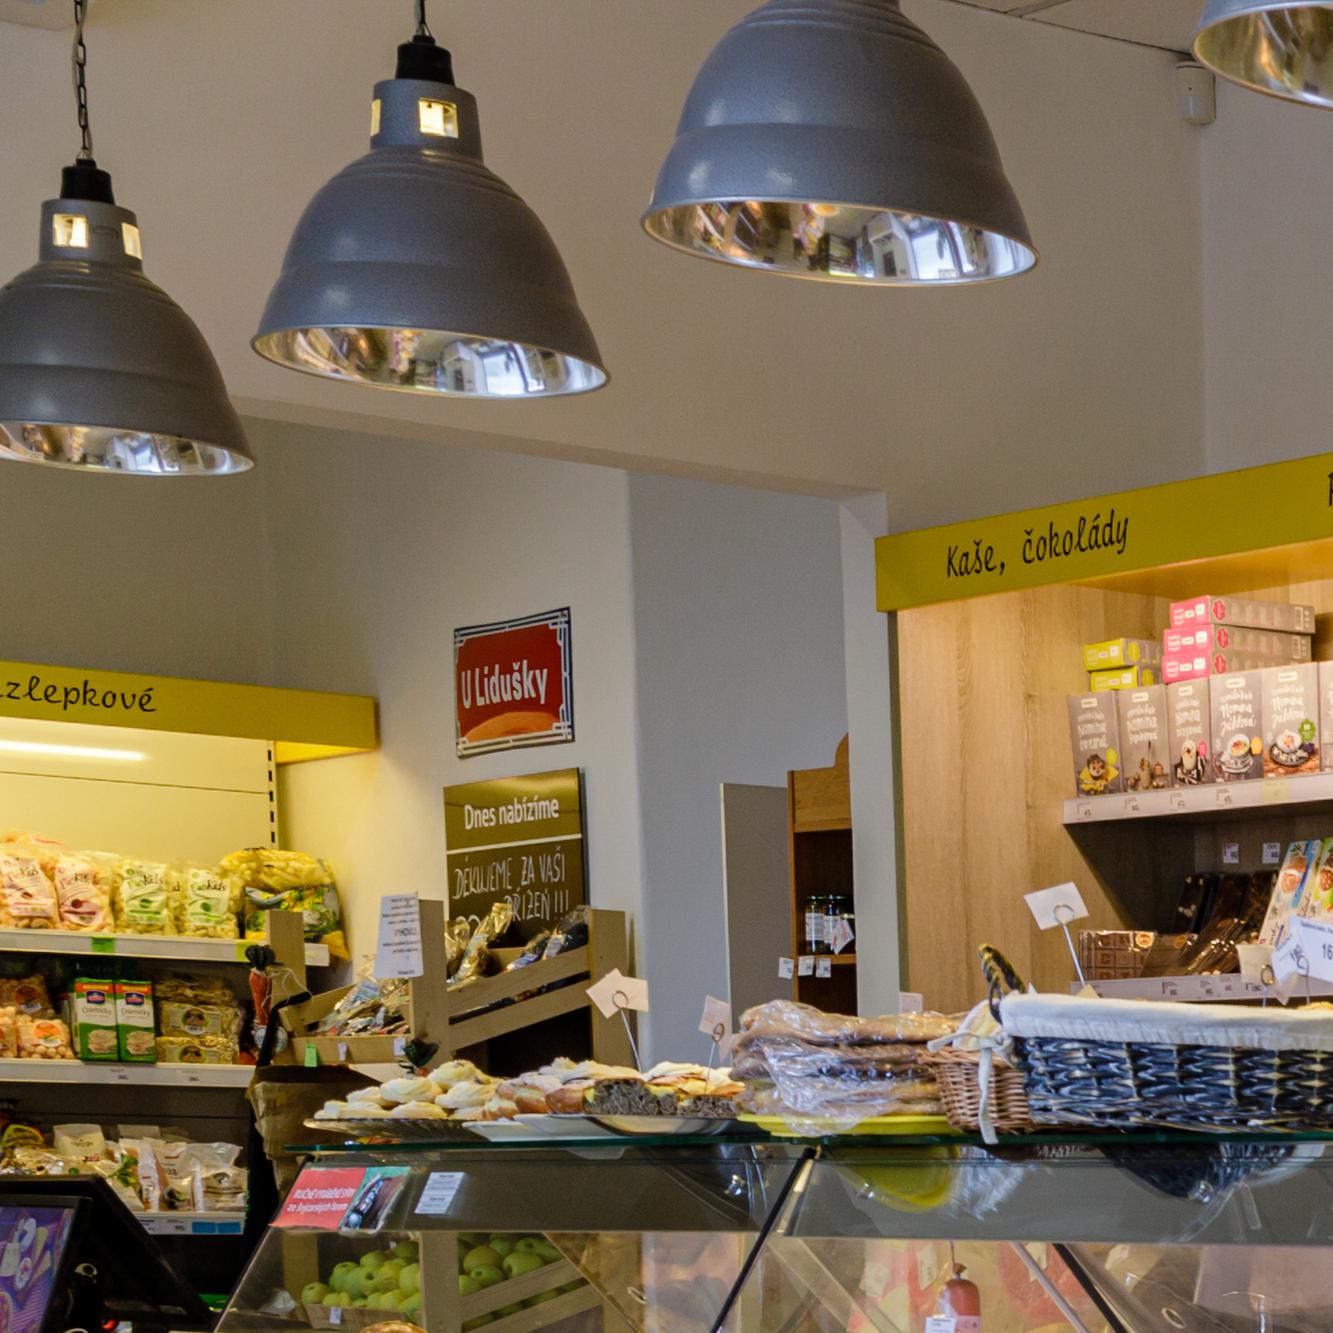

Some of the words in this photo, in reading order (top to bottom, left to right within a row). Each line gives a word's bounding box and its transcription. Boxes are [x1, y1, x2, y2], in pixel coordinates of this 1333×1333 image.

[947, 540, 1005, 578] Kaše,
[1022, 508, 1129, 556] čokolády
[0, 675, 157, 713] zlepkové
[461, 671, 471, 709] U
[475, 659, 548, 707] Lidušky
[464, 803, 497, 830] Dnes
[498, 794, 560, 826] nabízíme
